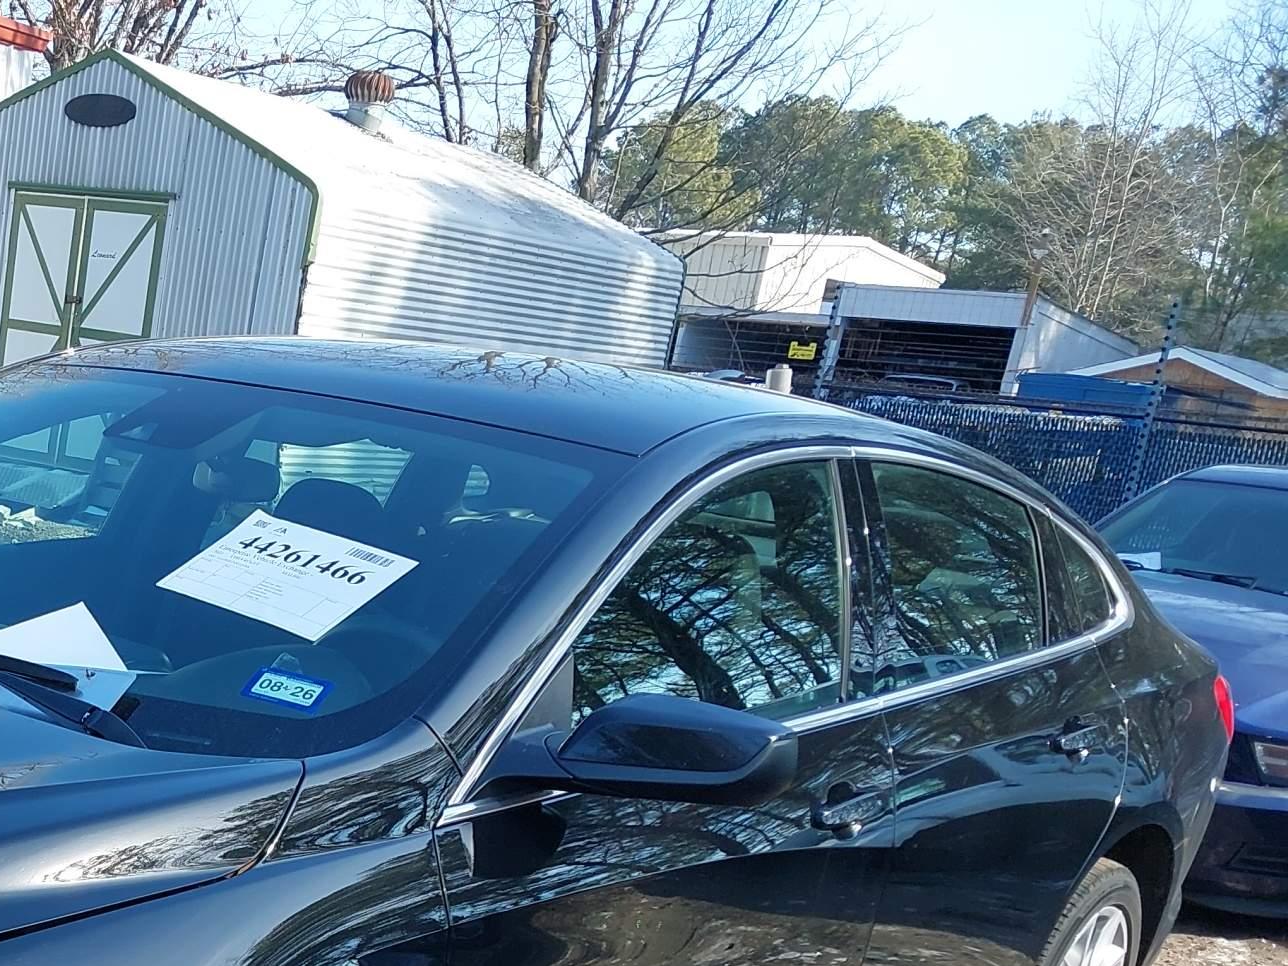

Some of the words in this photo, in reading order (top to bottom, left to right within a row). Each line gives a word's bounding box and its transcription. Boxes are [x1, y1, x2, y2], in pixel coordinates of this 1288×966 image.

[238, 536, 375, 585] 44261466
[259, 678, 284, 692] 08
[289, 686, 317, 700] 26
